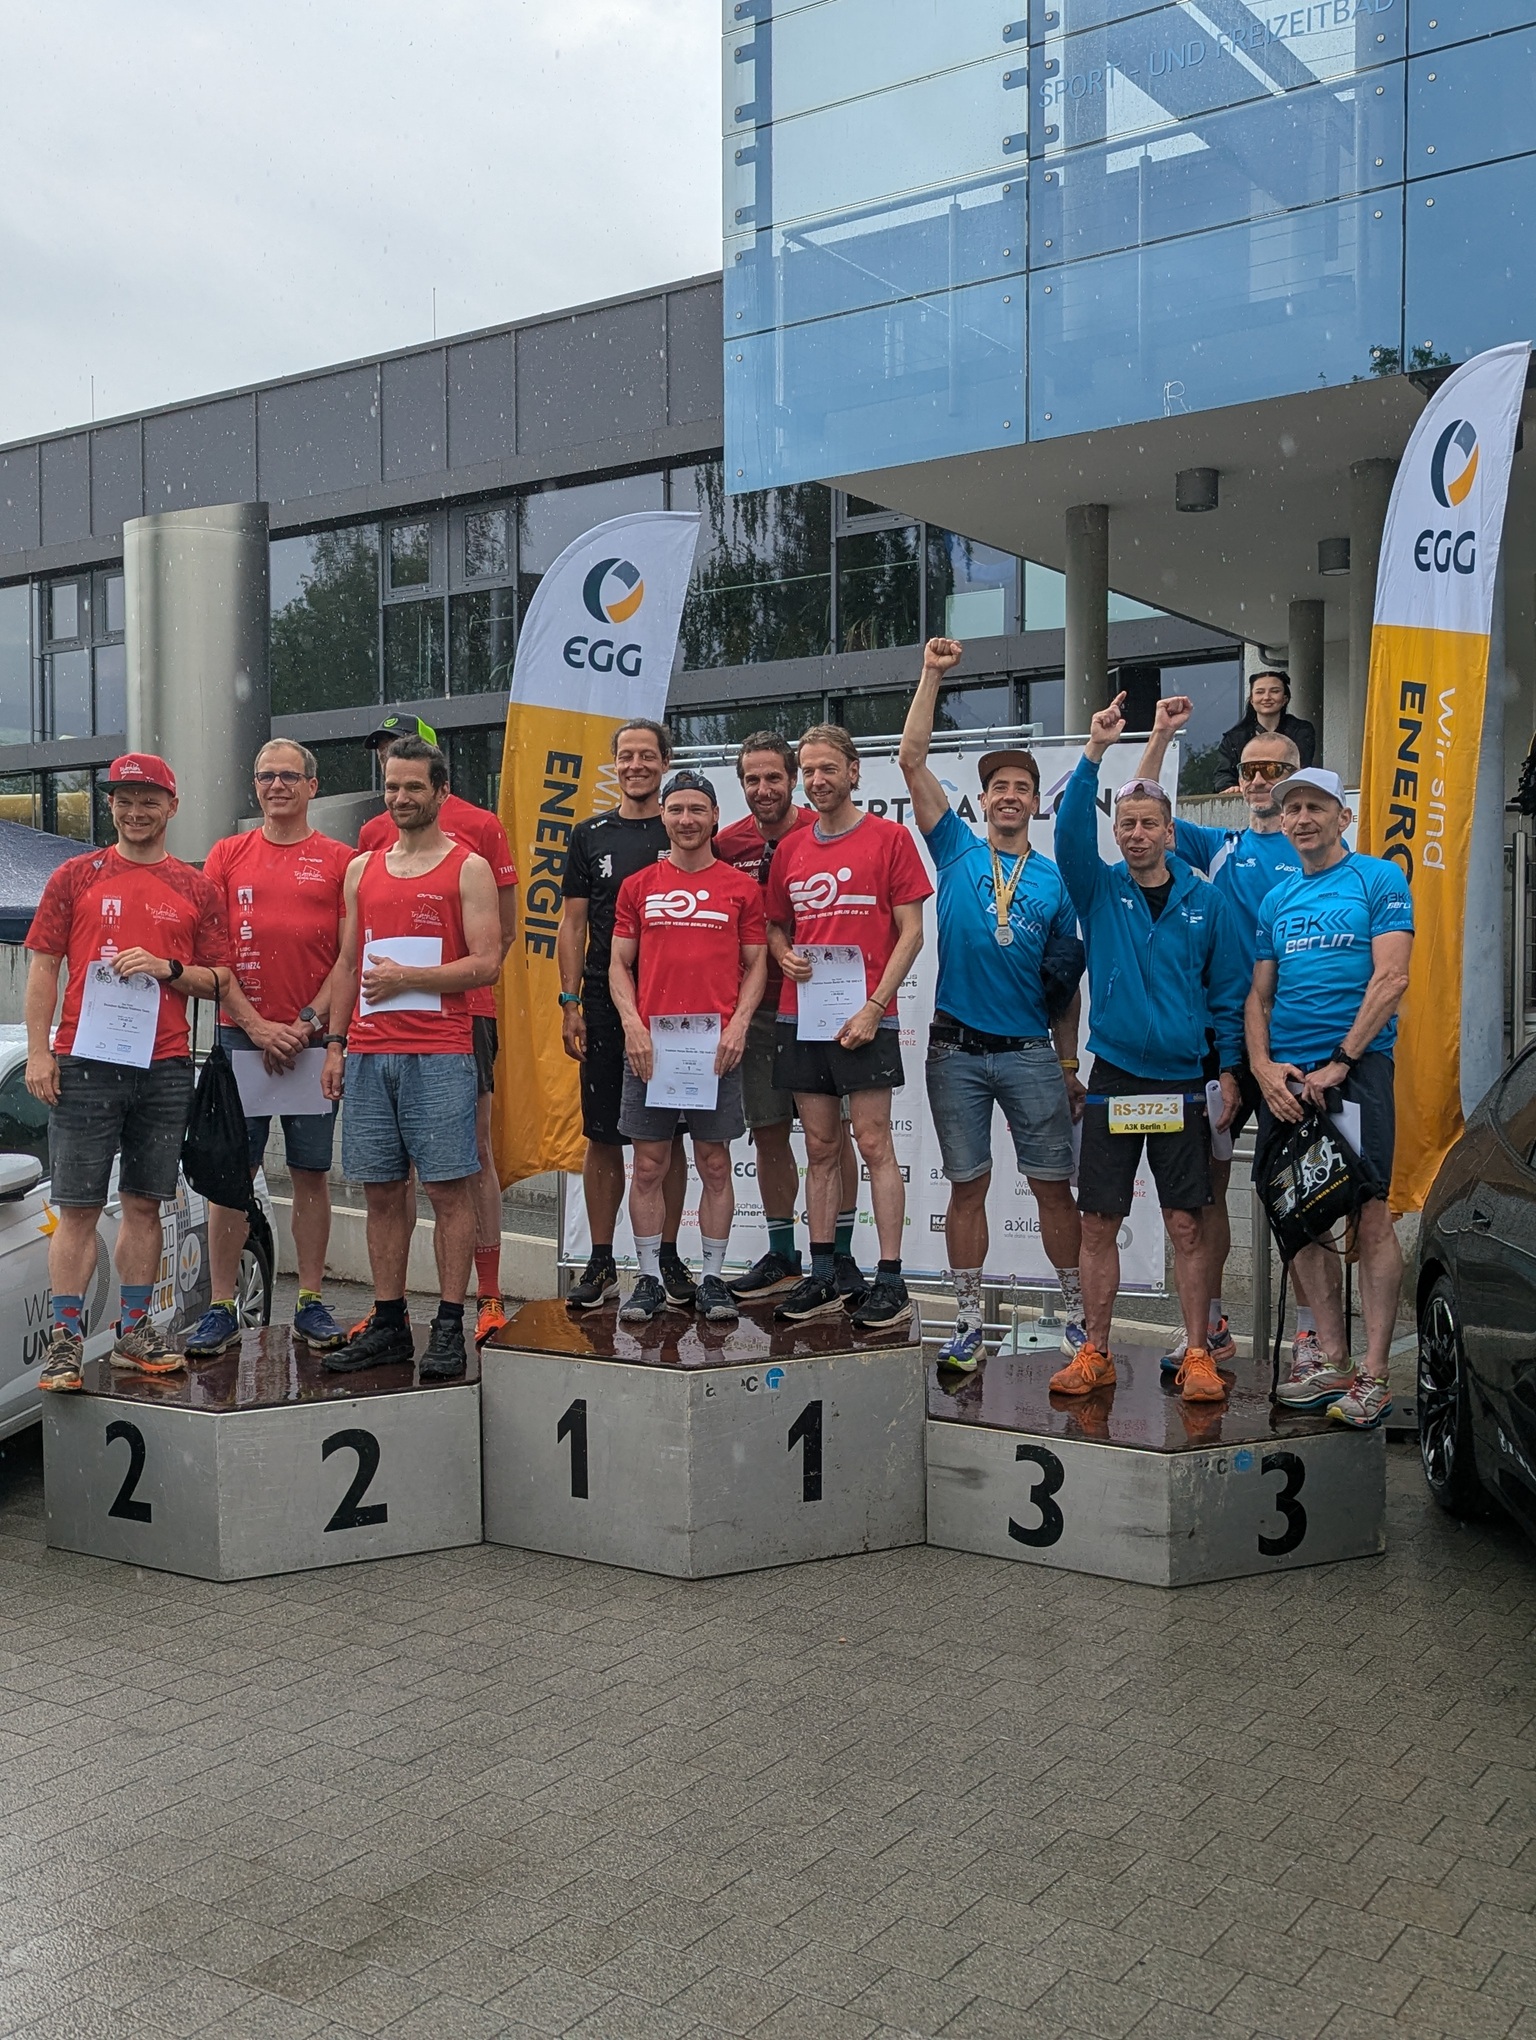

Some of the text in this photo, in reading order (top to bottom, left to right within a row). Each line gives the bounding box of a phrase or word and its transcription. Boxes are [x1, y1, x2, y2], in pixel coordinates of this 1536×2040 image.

[1038, 59, 1121, 109] SPORT
[1150, 40, 1208, 78] UND
[1215, 0, 1395, 58] FREIZEITBAD
[1414, 529, 1476, 575] EGG
[562, 635, 642, 678] EGG
[1382, 680, 1428, 887] ENER
[1422, 777, 1446, 871] sind
[1113, 1102, 1179, 1116] RS-372-3
[1124, 1122, 1167, 1131] A3K Berlin 1
[105, 1420, 152, 1524] 2
[321, 1428, 389, 1533] 2
[556, 1398, 589, 1500] 1
[787, 1400, 823, 1503] 1
[1008, 1443, 1066, 1548] 3
[1257, 1451, 1308, 1557] 3
